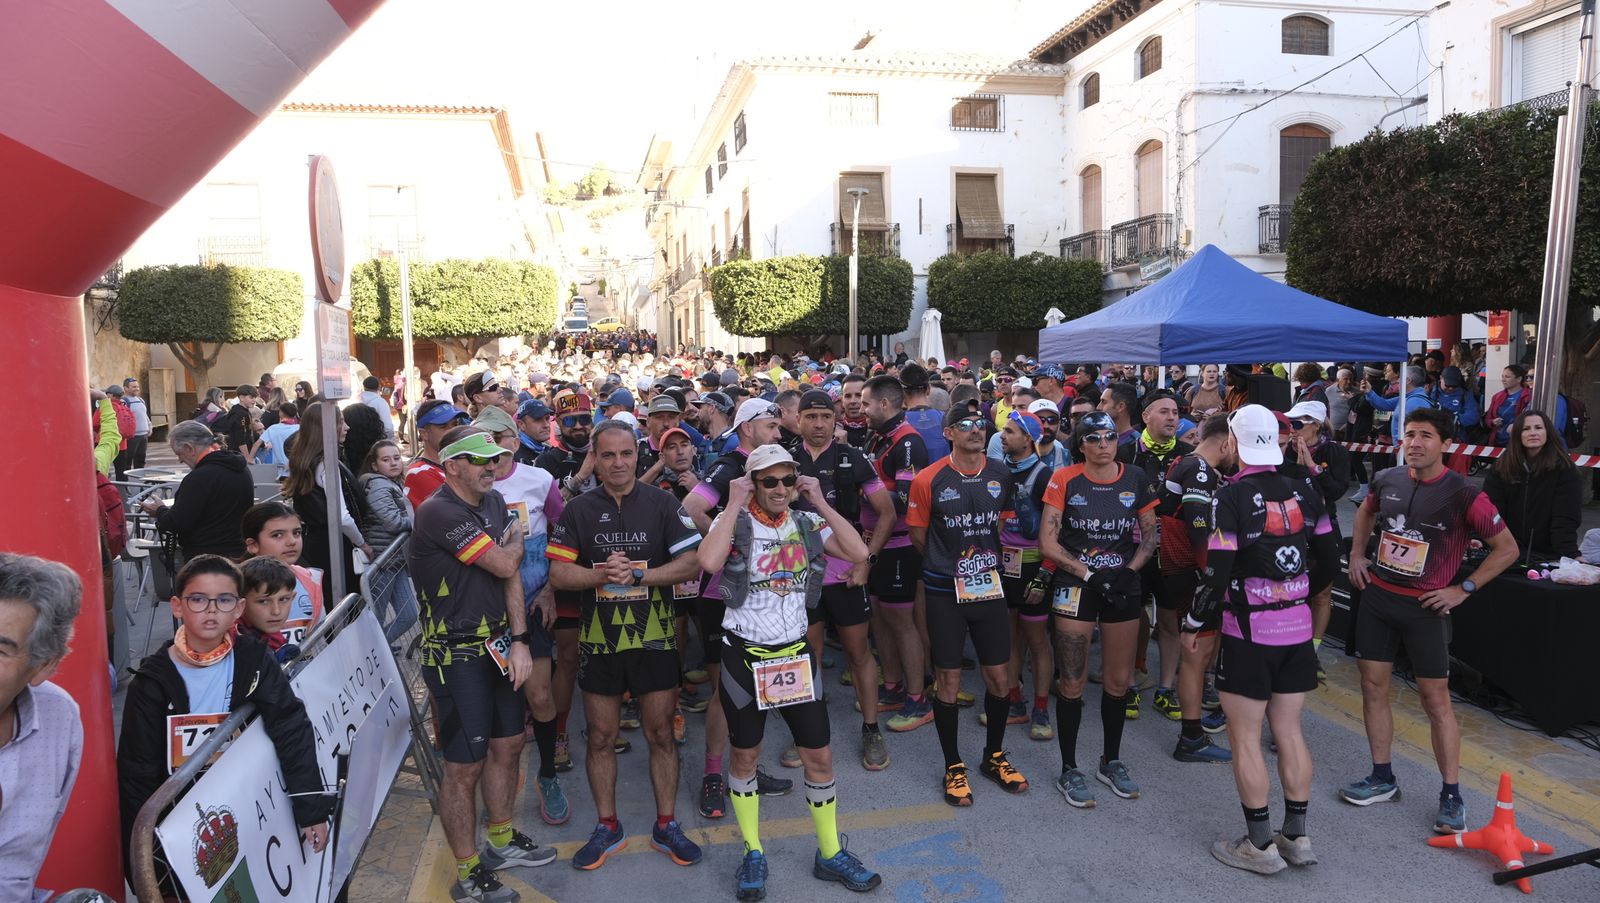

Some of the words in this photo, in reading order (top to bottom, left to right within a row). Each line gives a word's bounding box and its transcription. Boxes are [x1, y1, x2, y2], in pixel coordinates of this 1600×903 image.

[974, 512, 985, 525] del
[1102, 519, 1116, 530] del
[594, 532, 648, 544] CUELLAR
[1391, 543, 1410, 558] 77
[964, 574, 993, 587] 256
[366, 648, 380, 676] DE
[773, 671, 796, 687] 43
